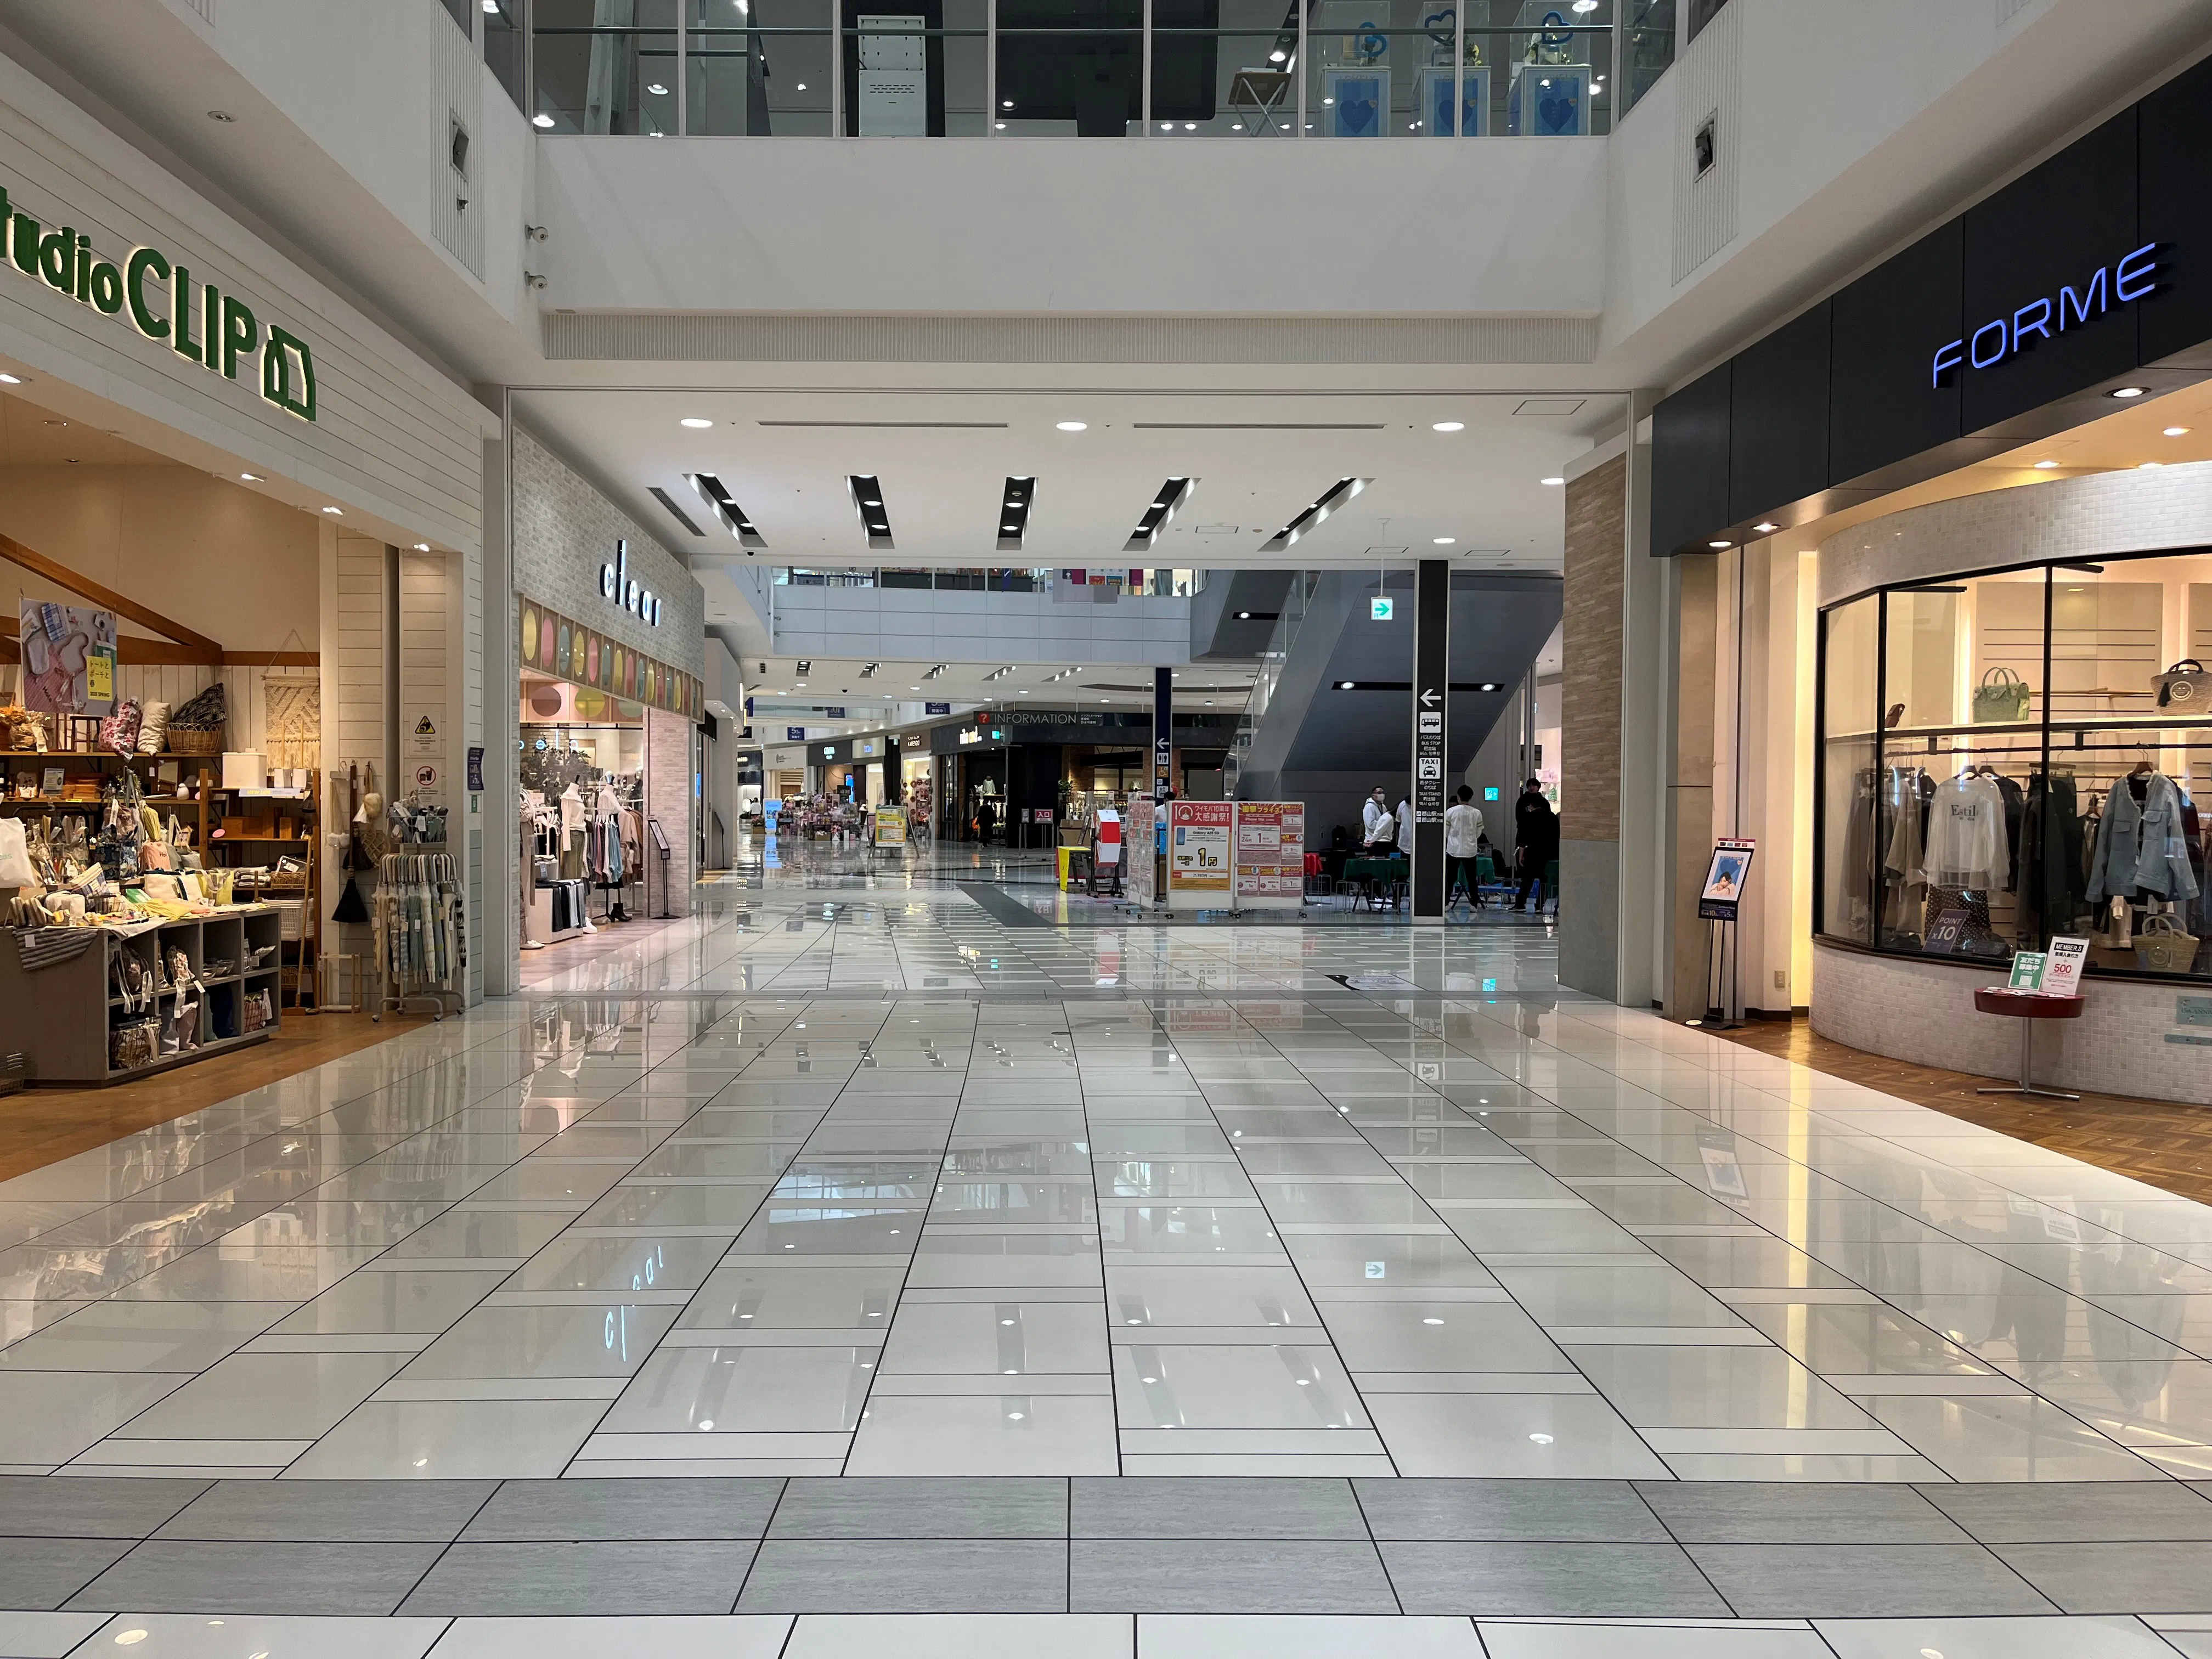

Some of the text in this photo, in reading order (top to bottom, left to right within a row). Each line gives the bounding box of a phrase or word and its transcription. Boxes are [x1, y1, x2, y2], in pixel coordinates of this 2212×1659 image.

[1933, 242, 2156, 389] FORME
[600, 539, 662, 627] clear
[89, 659, 110, 669] トートと
[89, 670, 110, 679] ポーチと
[994, 714, 1077, 724] INFORMATION
[1194, 812, 1229, 822] 大感謝祭!
[1938, 917, 1962, 925] POINT
[2020, 956, 2041, 964] 友だち
[2053, 963, 2072, 973] 500
